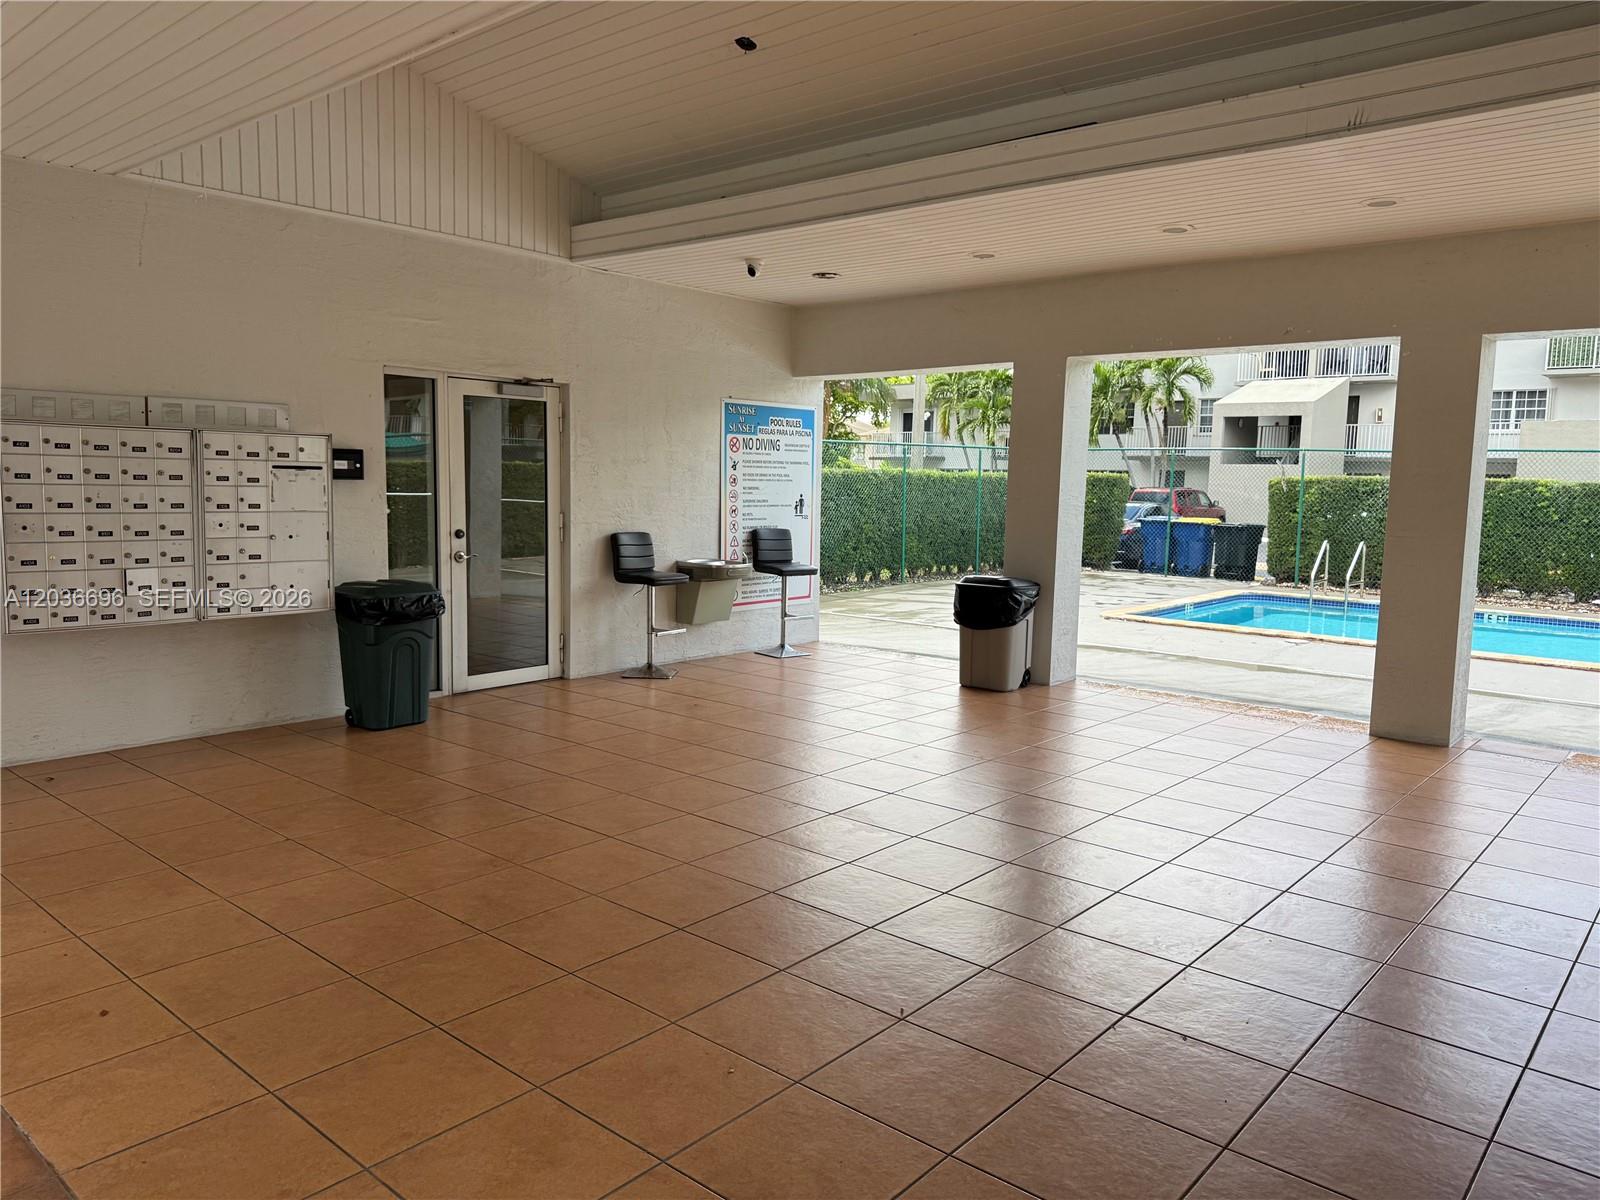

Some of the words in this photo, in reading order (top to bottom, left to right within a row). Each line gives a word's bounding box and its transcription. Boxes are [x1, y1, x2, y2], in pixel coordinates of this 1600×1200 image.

[728, 404, 757, 416] SUNRISE
[728, 422, 755, 433] SUNSET
[770, 418, 784, 427] POOL
[785, 419, 802, 428] RULES
[758, 427, 776, 435] REGLAS
[742, 437, 754, 450] NO
[755, 438, 781, 452] DIVING
